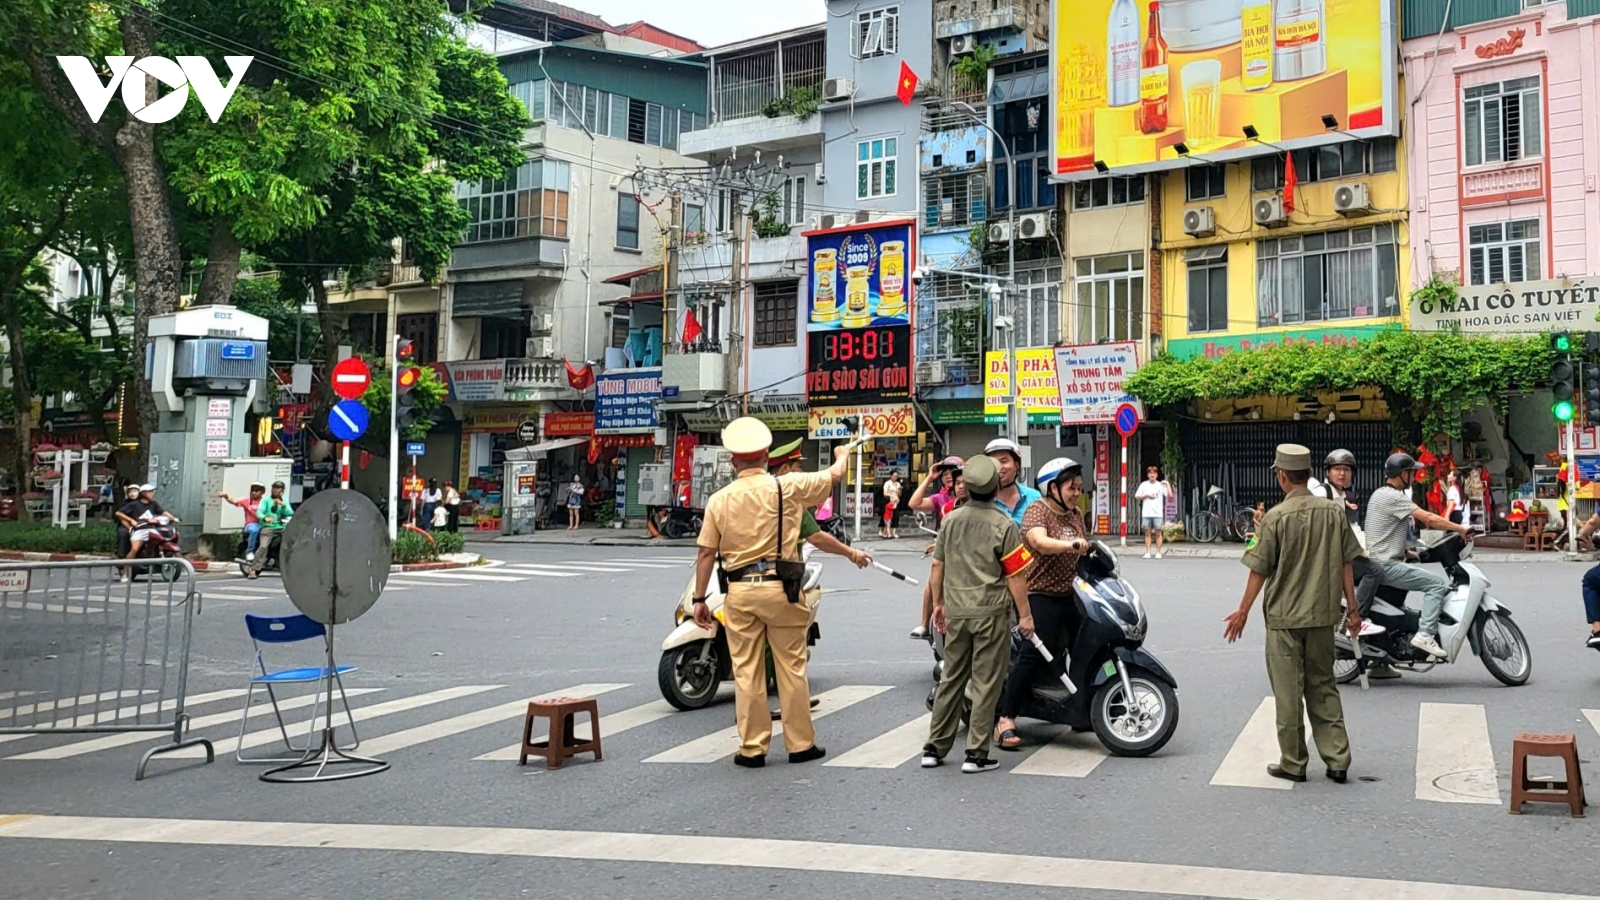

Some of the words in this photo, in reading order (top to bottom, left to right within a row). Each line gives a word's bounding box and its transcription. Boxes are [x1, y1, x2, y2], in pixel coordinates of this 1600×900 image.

[847, 243, 868, 253] Since
[847, 252, 868, 264] 2009
[1440, 296, 1480, 314] MAI
[1486, 288, 1515, 310] CÔ
[1522, 280, 1599, 308] TUYẾT
[1465, 317, 1490, 327] HOA
[1494, 313, 1520, 328] ĐẶC
[1554, 308, 1582, 324] VIỆT
[832, 331, 894, 361] 13:01
[833, 365, 857, 391] SÀO
[860, 364, 880, 390] SÀI
[882, 362, 907, 389] GÒN
[1072, 367, 1100, 378] TRUNG
[1094, 380, 1106, 394] TỰ
[764, 403, 780, 413] TIVI
[781, 403, 795, 414] TẠI
[797, 403, 809, 412] NH
[862, 414, 908, 435] 20%
[815, 428, 833, 437] LÊN
